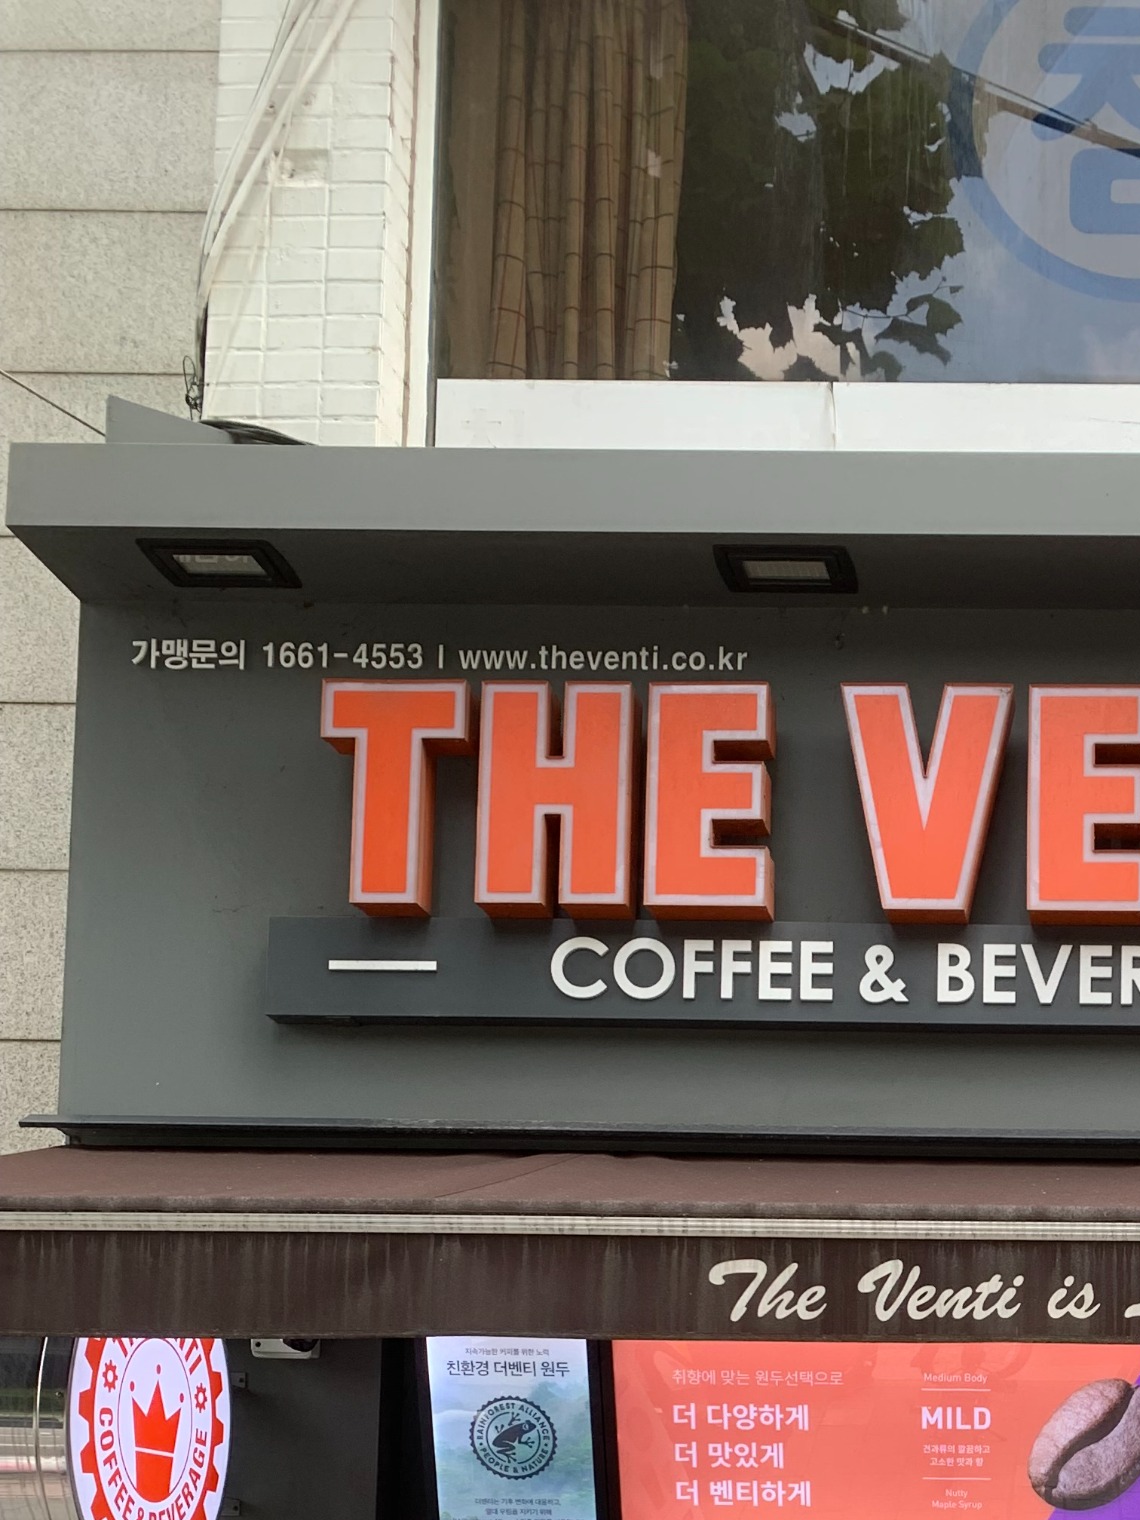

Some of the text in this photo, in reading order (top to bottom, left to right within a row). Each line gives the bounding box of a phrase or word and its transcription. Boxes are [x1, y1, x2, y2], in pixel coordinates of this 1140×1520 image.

[130, 639, 749, 672] 가맹문의 1661-4553 www.theventi.co.kr
[320, 678, 776, 922] THE
[549, 936, 835, 1002] COFFEE
[859, 944, 908, 1004] &
[708, 1258, 828, 1323] The
[857, 1258, 1026, 1322] Venti
[1046, 1274, 1101, 1321] is
[446, 1360, 571, 1378] 친환경 더벤티 원두
[672, 1369, 844, 1388] 취향에 맞는 원두선택으로
[924, 1372, 988, 1385] Medium Body
[476, 1402, 550, 1441] RAINFOREST ALLIANCE
[673, 1403, 810, 1431] 더 다양하게
[921, 1406, 992, 1430] MILD
[481, 1447, 510, 1473] PEOPLE
[521, 1448, 550, 1473] NATURE
[674, 1442, 785, 1469] 더 맛있게
[930, 1457, 954, 1467] 고소한
[676, 1481, 812, 1507] 더 벤티하게
[931, 1500, 983, 1511] Maple Syrup
[945, 1488, 968, 1498] Nutty
